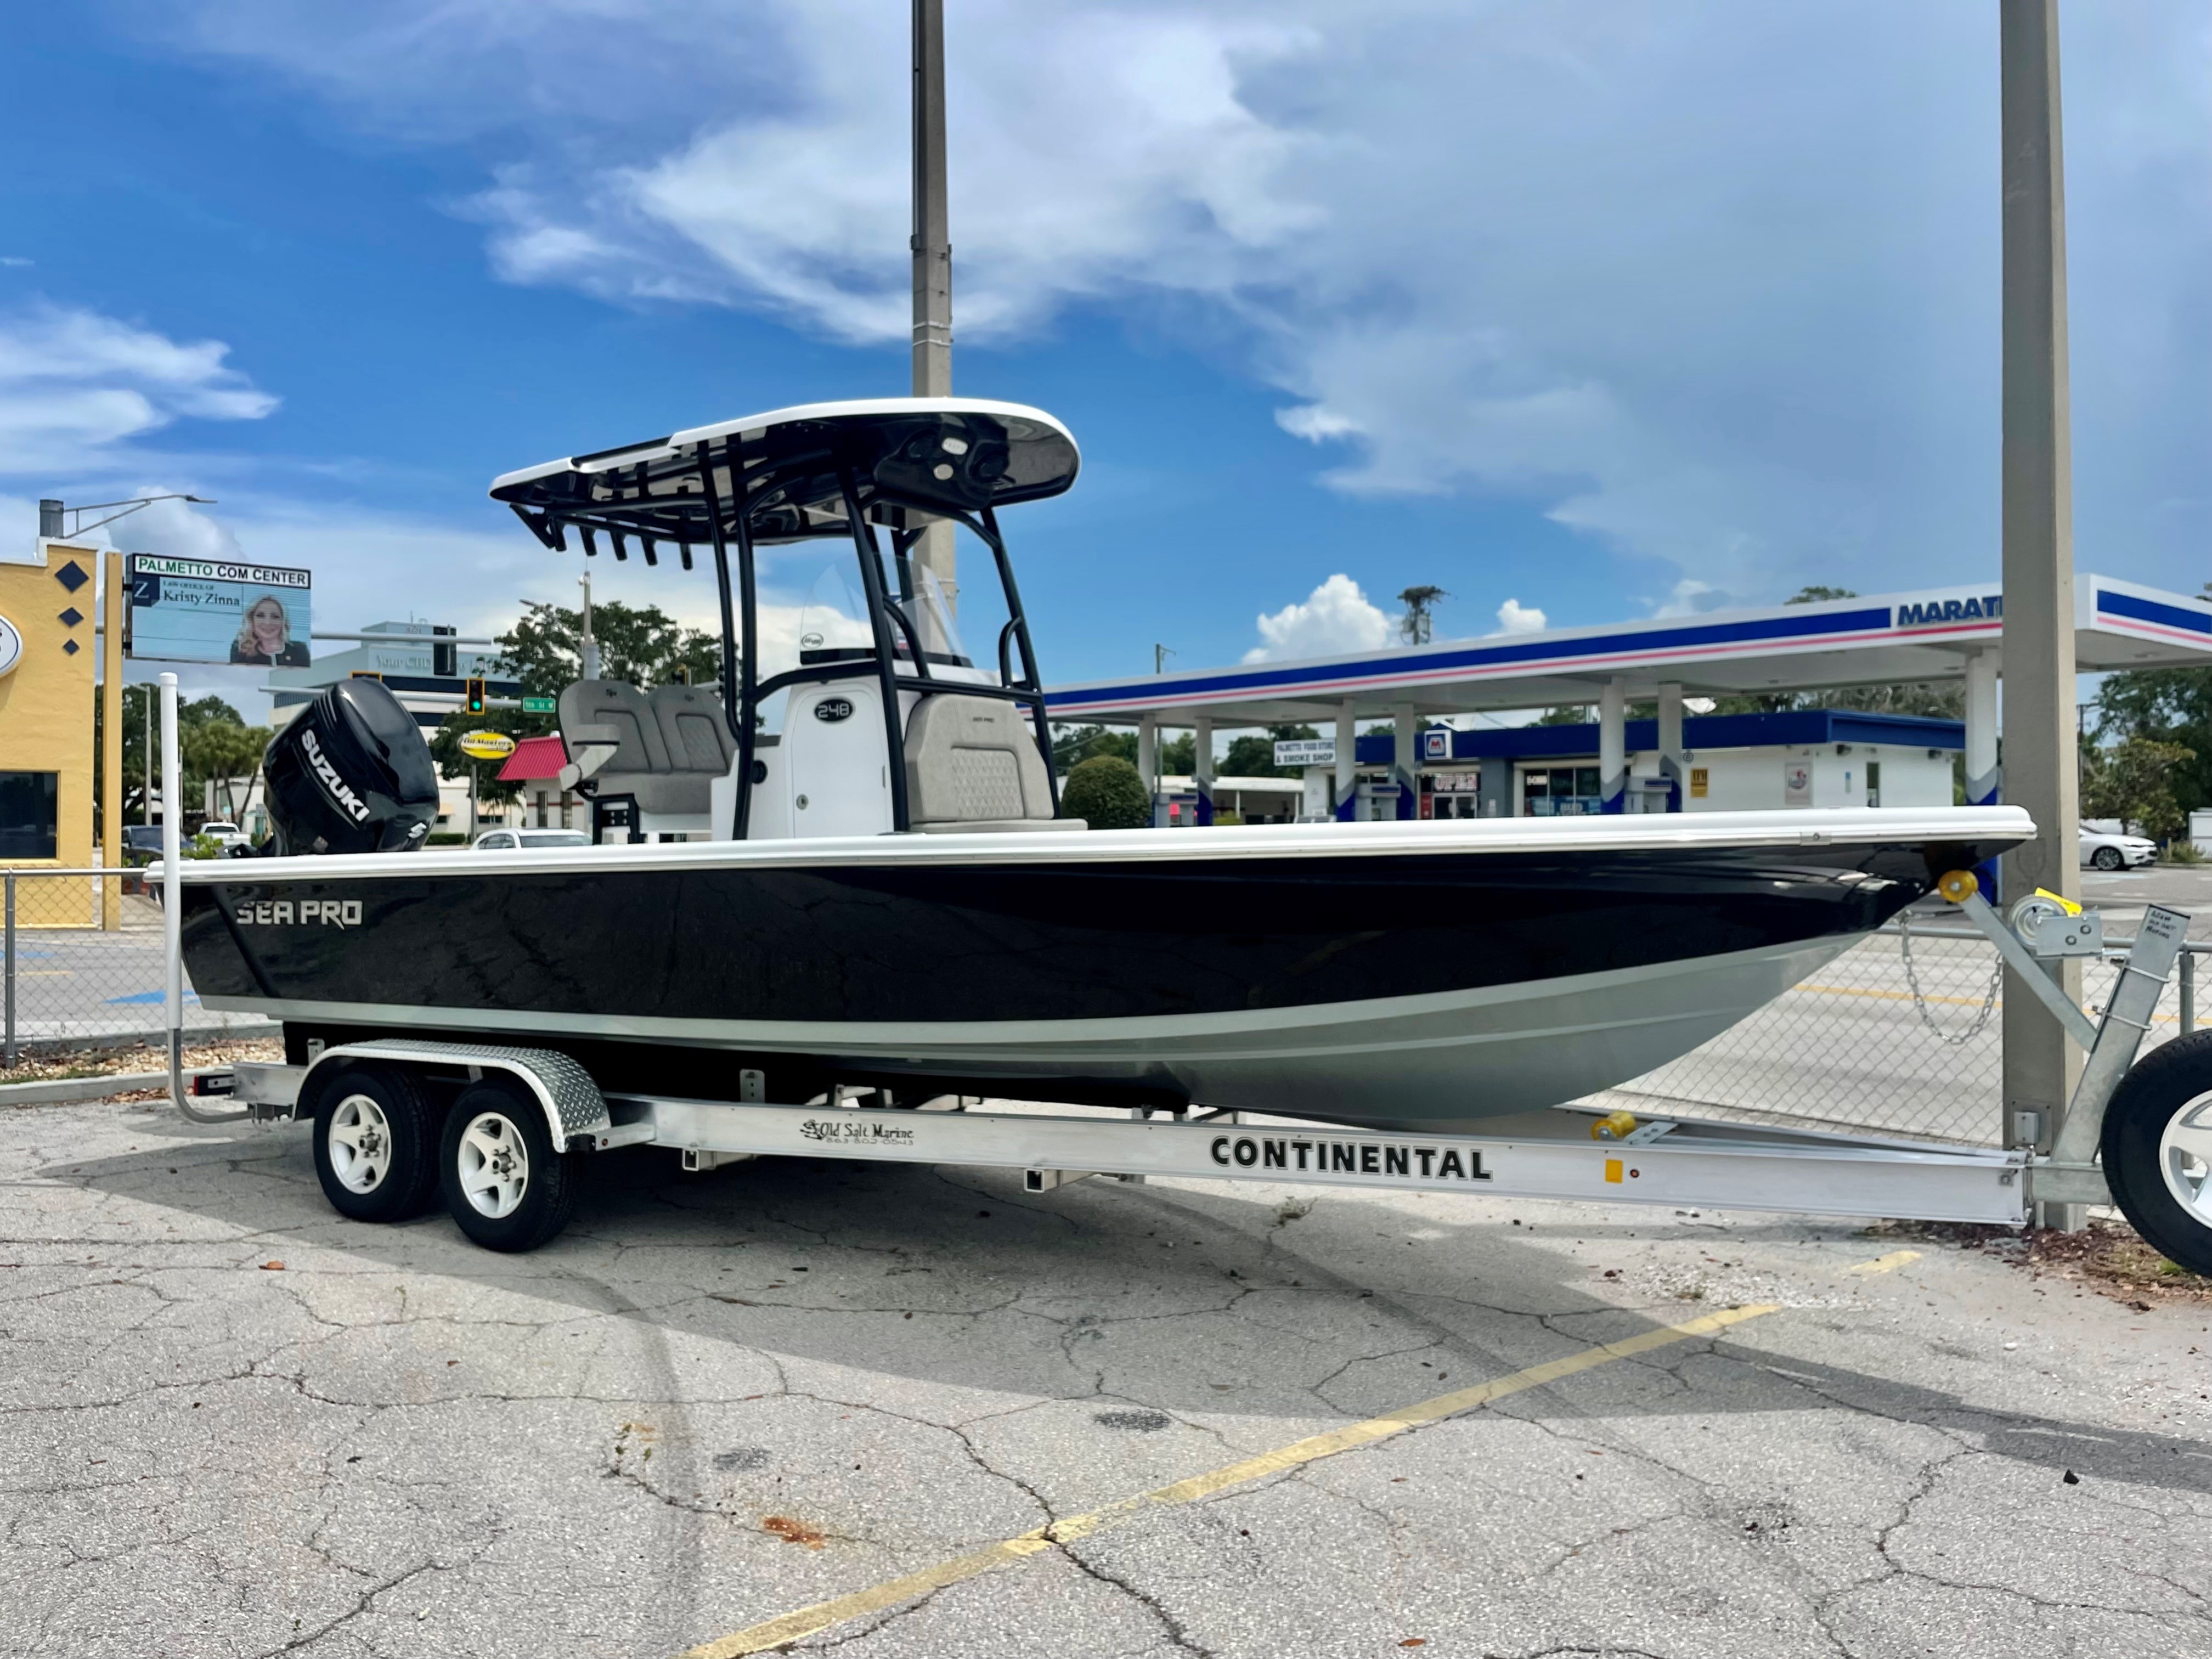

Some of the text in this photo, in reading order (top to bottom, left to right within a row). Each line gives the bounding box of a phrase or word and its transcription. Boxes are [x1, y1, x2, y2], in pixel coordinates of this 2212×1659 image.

[139, 557, 306, 585] PALMETTO COM CENTER
[134, 580, 149, 599] Z
[164, 589, 240, 606] Kristy Zinna
[817, 703, 850, 718] 248
[302, 729, 370, 822] SUZUKI
[1434, 774, 1477, 791] OPEN
[236, 900, 363, 930] SEA PRO
[820, 1122, 915, 1139] Old Salt Marine
[1211, 1135, 1493, 1183] CONTINENTAL
